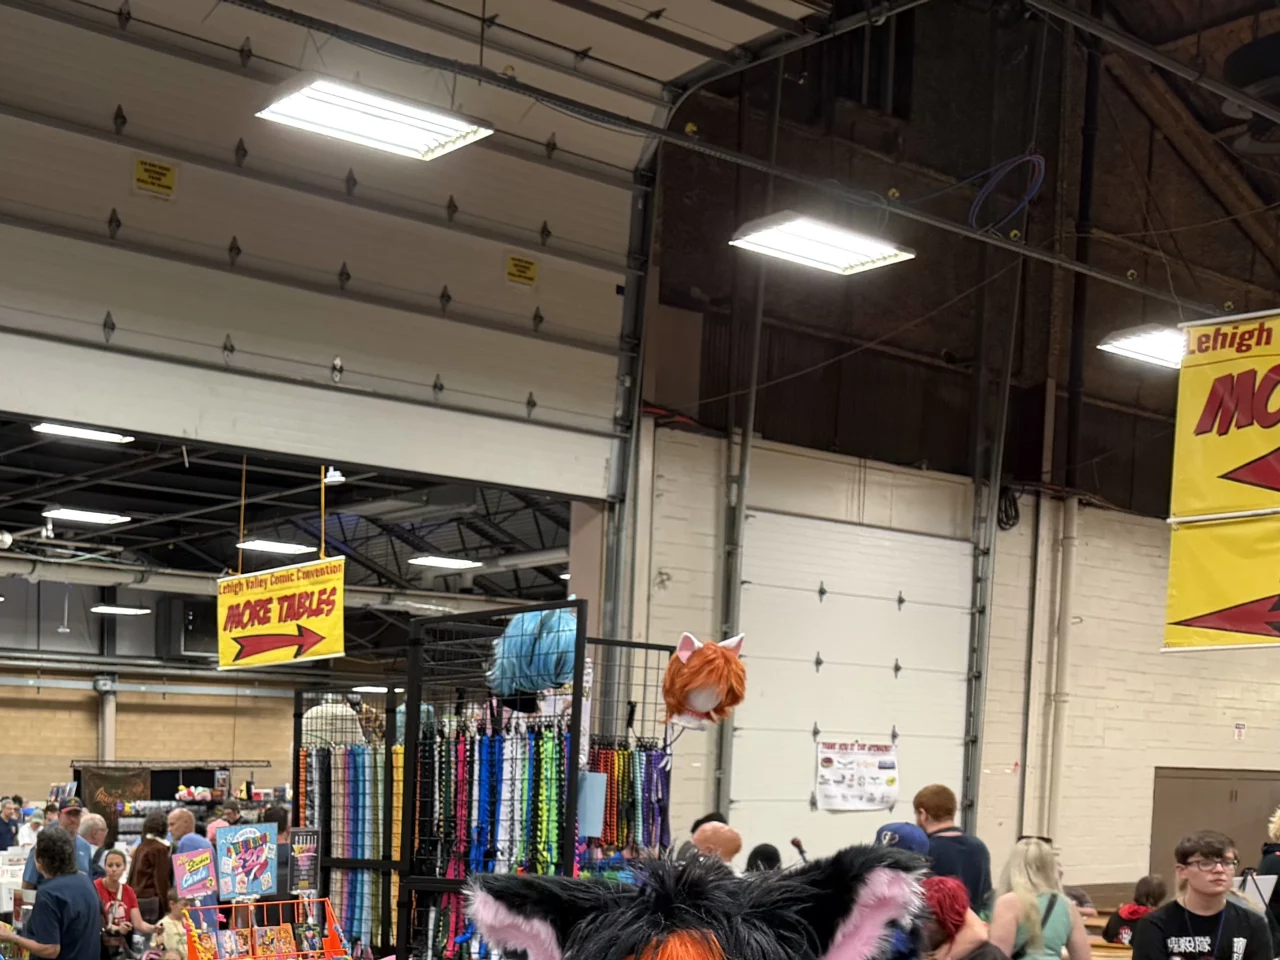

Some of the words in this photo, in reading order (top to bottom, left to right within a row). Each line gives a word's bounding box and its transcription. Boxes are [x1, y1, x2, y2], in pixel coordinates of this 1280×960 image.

[1186, 322, 1273, 355] Lehigh
[219, 583, 243, 595] Lehigh
[245, 577, 268, 591] Valley
[270, 573, 294, 586] Comic
[297, 564, 342, 580] Convention
[223, 597, 273, 632] MORE
[277, 586, 337, 622] TABLES
[183, 866, 207, 888] Cards
